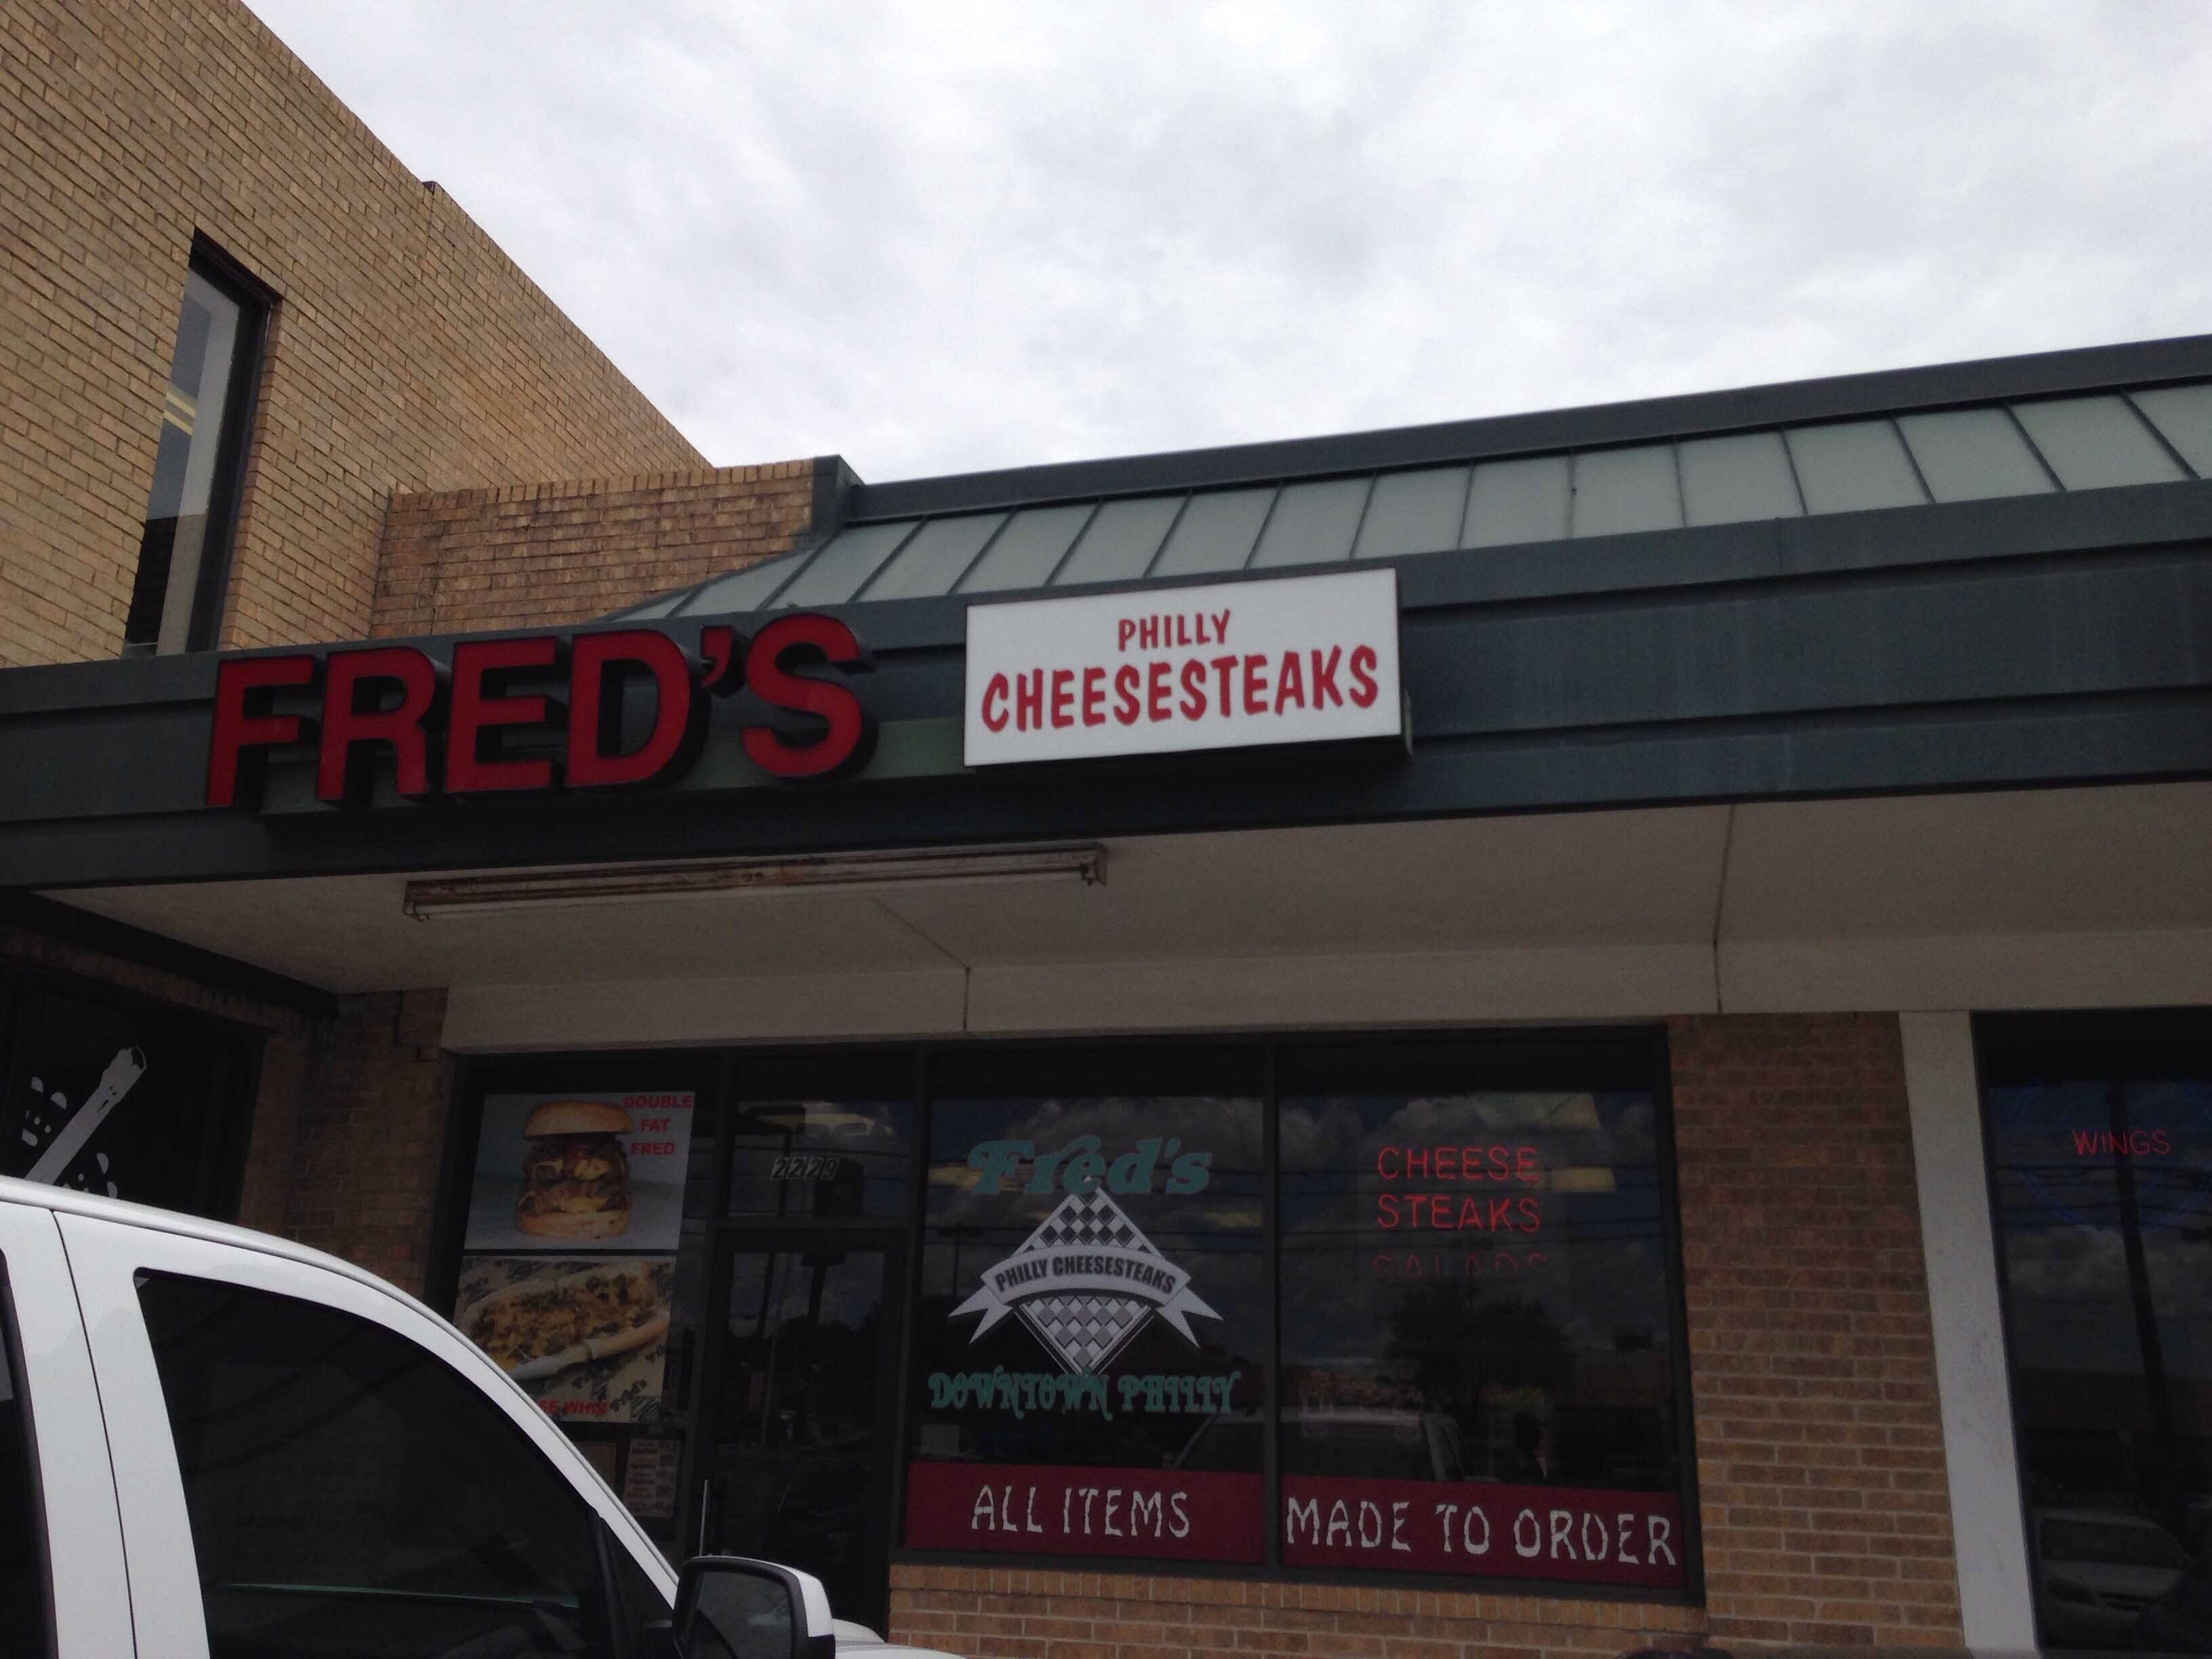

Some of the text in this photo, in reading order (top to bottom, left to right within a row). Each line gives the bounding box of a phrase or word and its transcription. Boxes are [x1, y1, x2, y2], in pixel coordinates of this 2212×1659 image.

[1118, 609, 1231, 651] PHILLY
[981, 644, 1378, 733] CHEESESTEAKS
[206, 613, 863, 808] FRED'S
[623, 1095, 693, 1109] DOUBLE
[640, 1118, 671, 1132] FAT
[2072, 1130, 2172, 1155] WINGS
[630, 1142, 676, 1155] FRED
[968, 1134, 1213, 1195] Fred's
[1376, 1145, 1541, 1182] CHEESE
[1376, 1193, 1541, 1233] STEAKS
[994, 1254, 1176, 1293] PHILLY CHEESESTEAKS
[927, 1364, 1242, 1421] DOWNTOWN PHILLY
[971, 1485, 1191, 1538] ALL ITEMS
[1286, 1496, 1677, 1567] MADE TO ORDER
